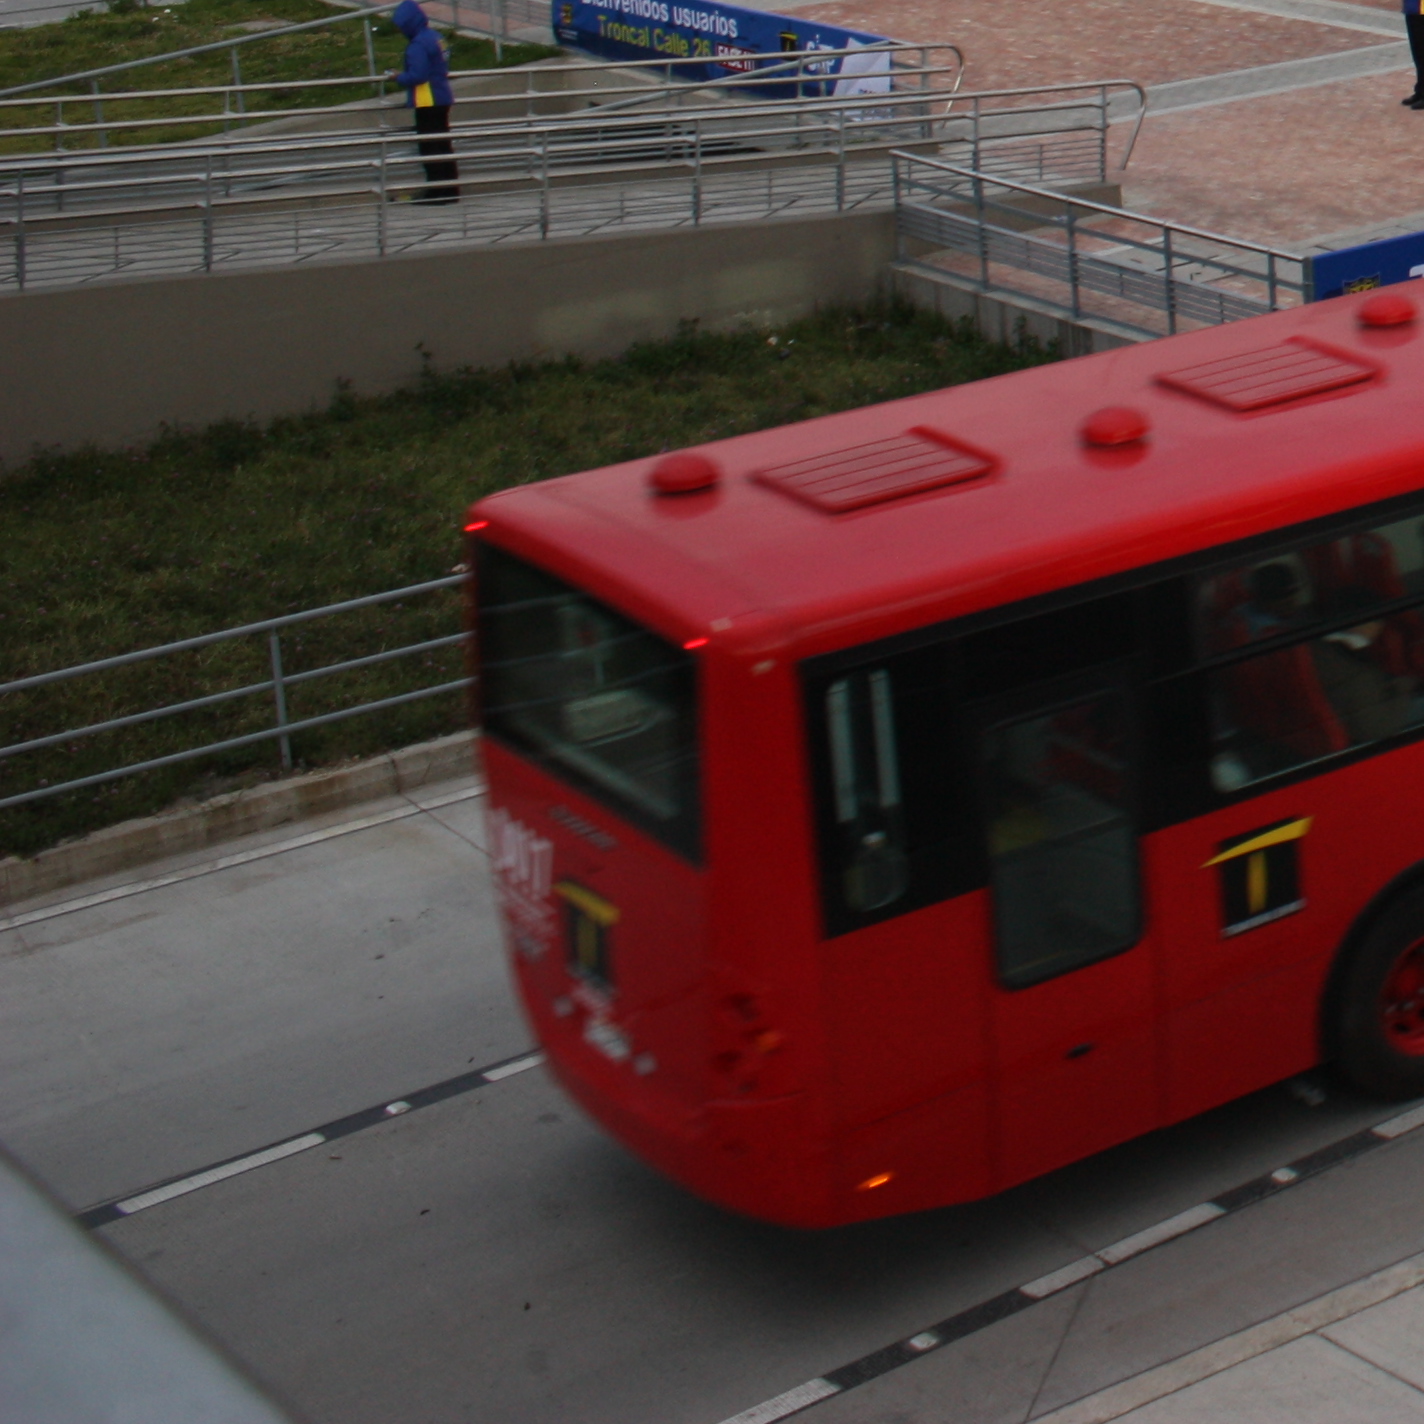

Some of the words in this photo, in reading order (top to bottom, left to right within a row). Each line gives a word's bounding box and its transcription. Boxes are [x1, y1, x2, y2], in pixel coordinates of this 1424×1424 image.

[598, 15, 650, 48] Troncal
[653, 28, 689, 57] Calle
[673, 6, 739, 38] usuarios
